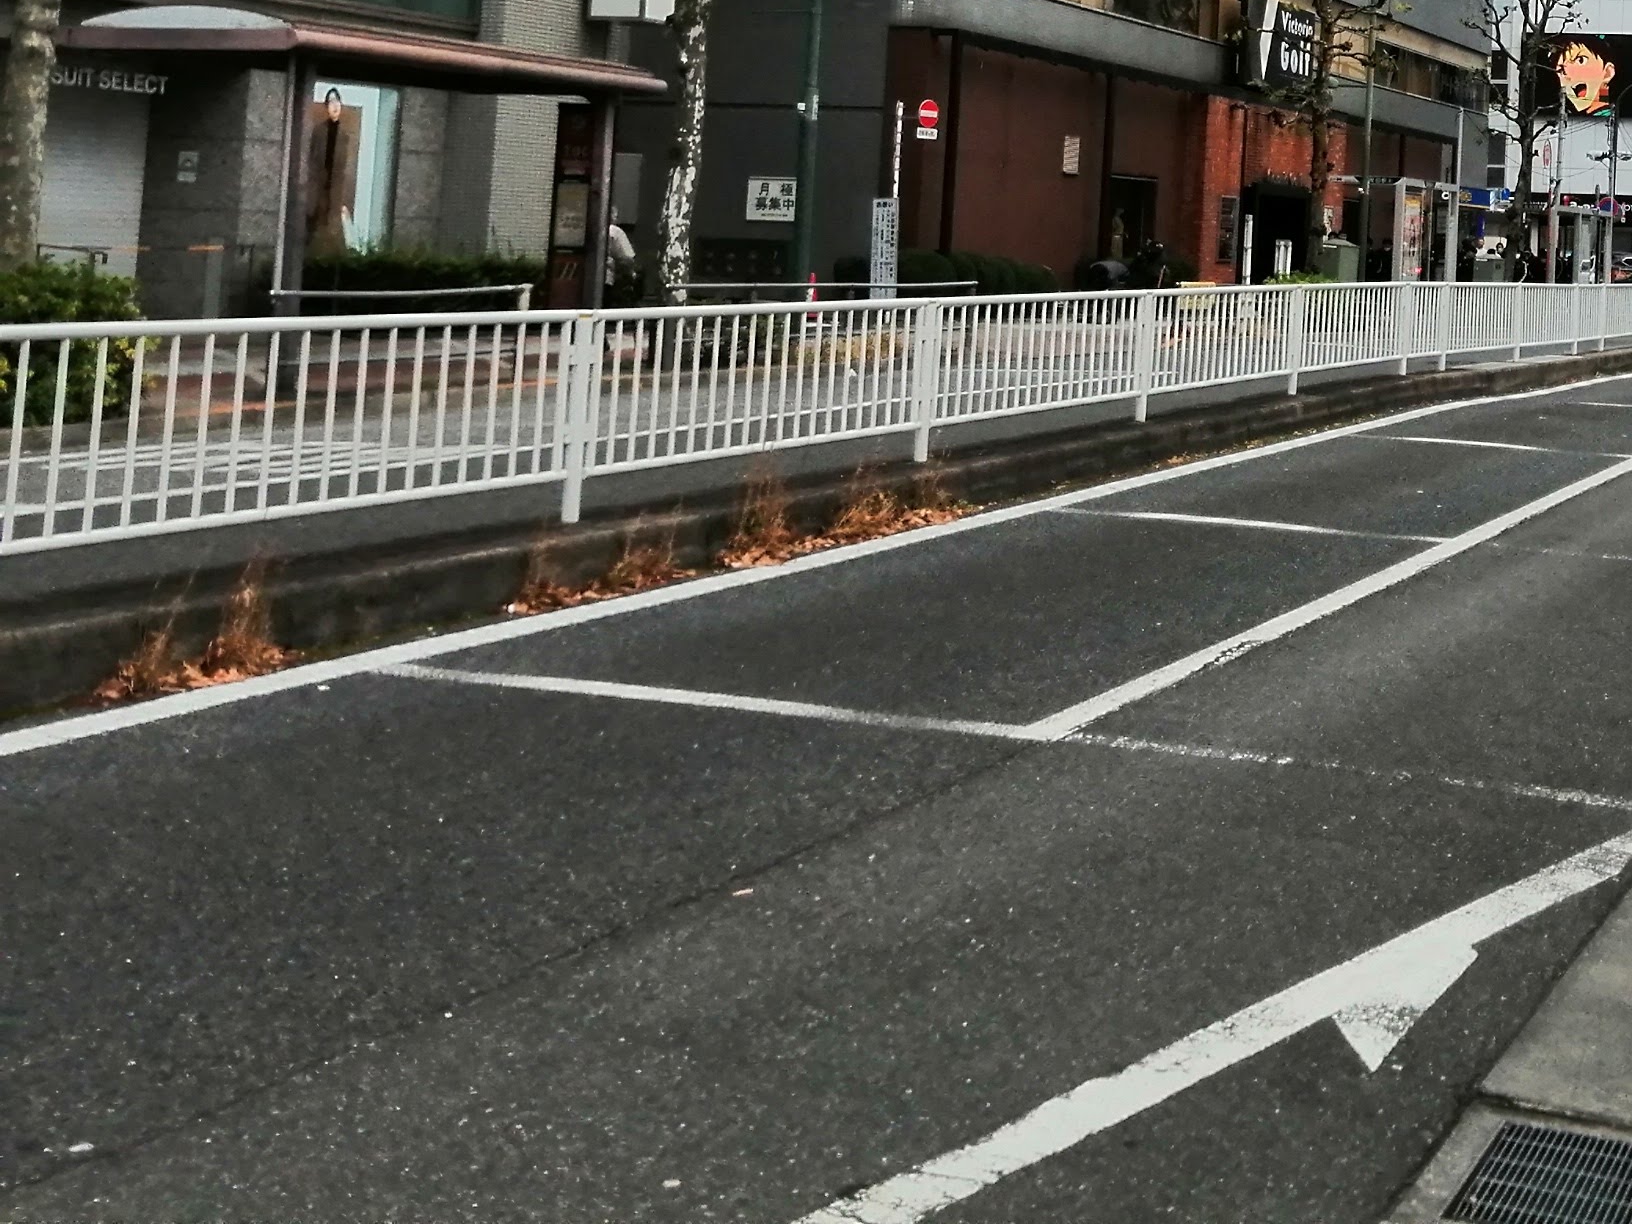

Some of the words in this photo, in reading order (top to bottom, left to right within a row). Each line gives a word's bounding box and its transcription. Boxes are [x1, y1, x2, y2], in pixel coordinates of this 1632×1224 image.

[1281, 10, 1314, 37] Victoria
[1280, 40, 1312, 76] Golf
[51, 66, 95, 88] SUIT
[99, 69, 169, 95] SELECT
